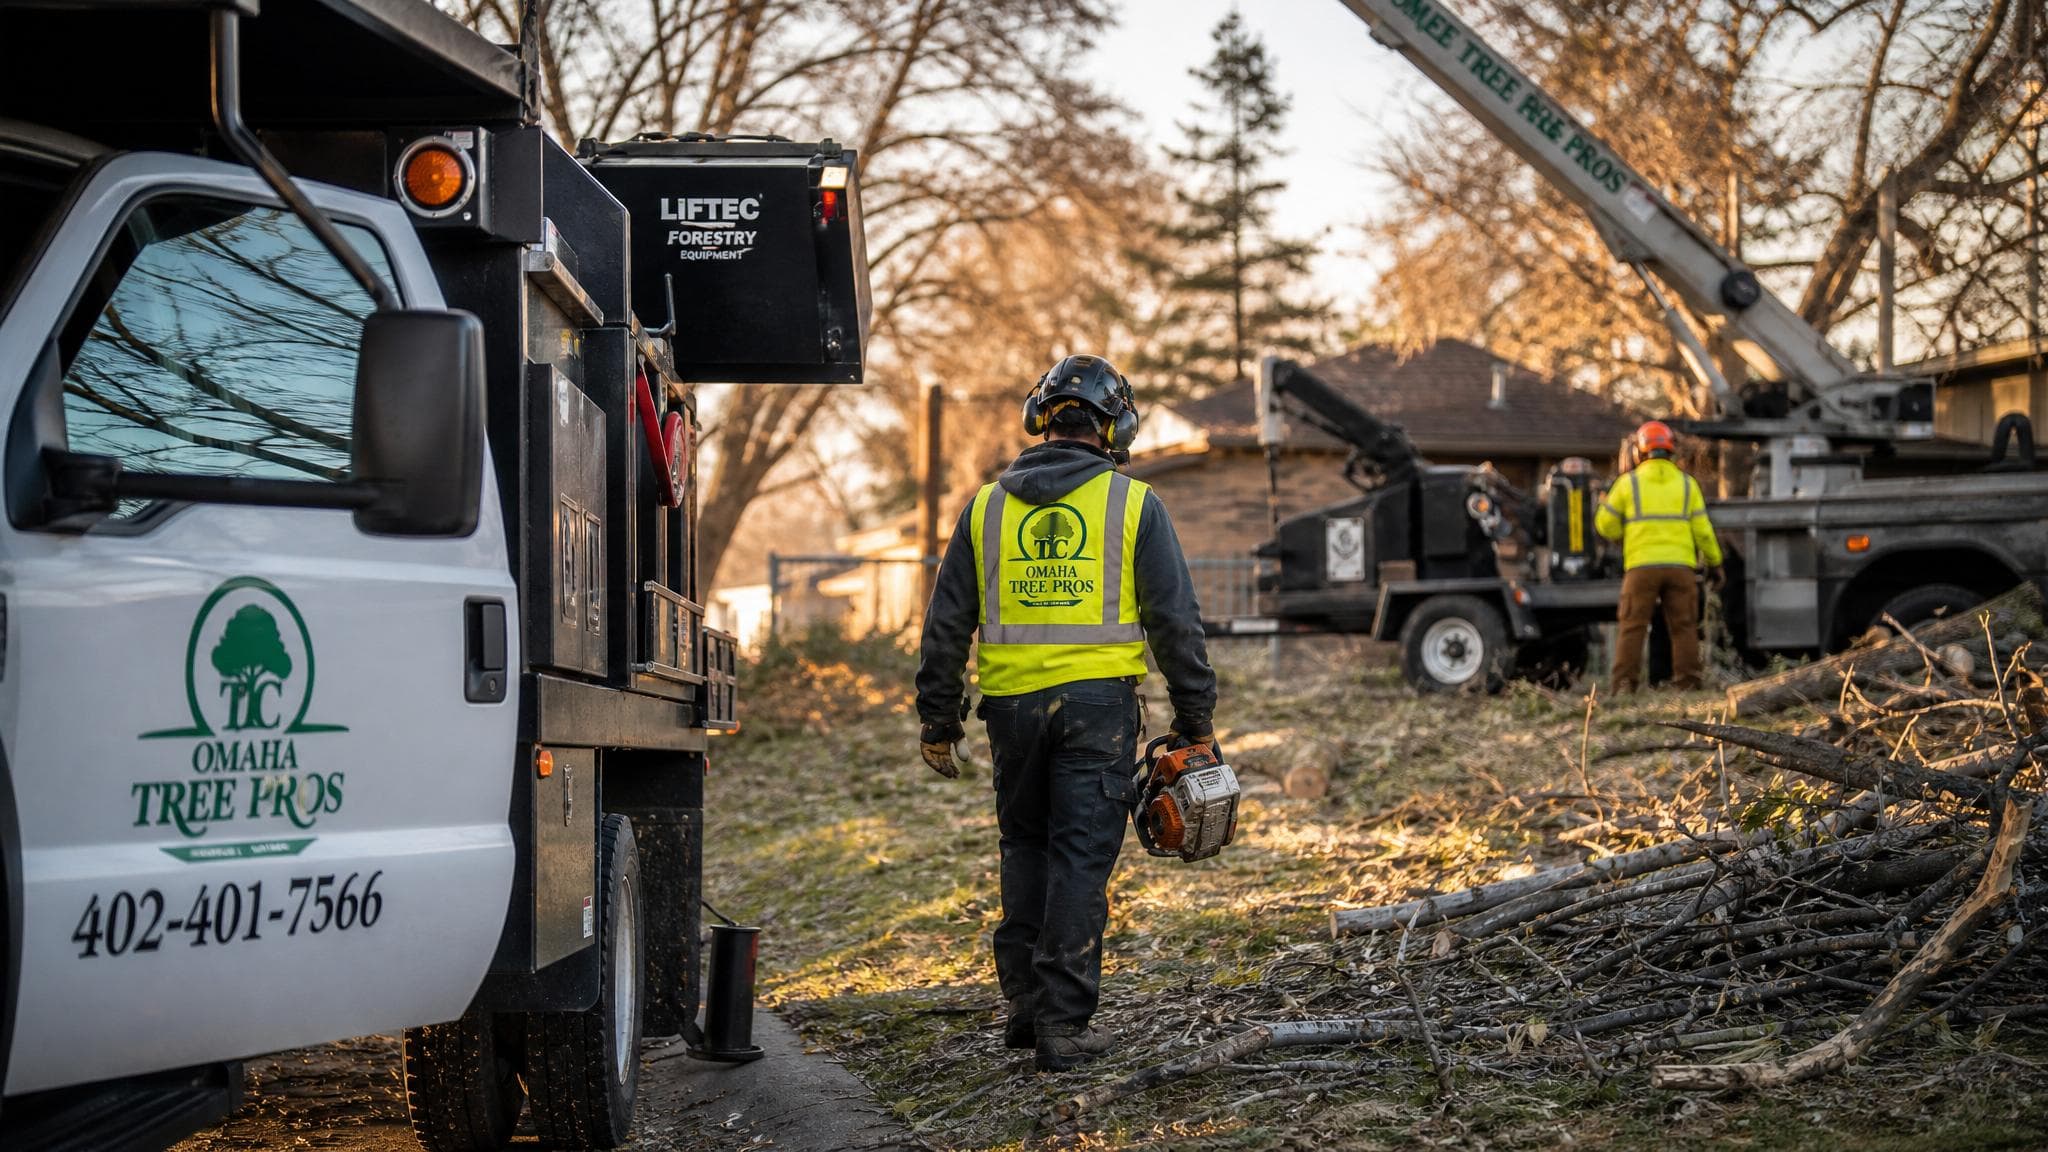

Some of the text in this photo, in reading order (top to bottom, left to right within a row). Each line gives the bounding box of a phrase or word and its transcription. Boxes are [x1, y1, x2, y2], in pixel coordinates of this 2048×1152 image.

[1457, 40, 1522, 103] TREE
[1562, 133, 1627, 193] PROS
[667, 230, 757, 246] FORESTRY
[680, 250, 743, 260] EQUIPMENT
[1026, 566, 1077, 578] OMAHA
[1009, 579, 1094, 598] TREE PROS
[192, 738, 299, 773] OMAHA
[131, 772, 345, 838] TREE PROS
[71, 870, 384, 960] 402-401-7566
